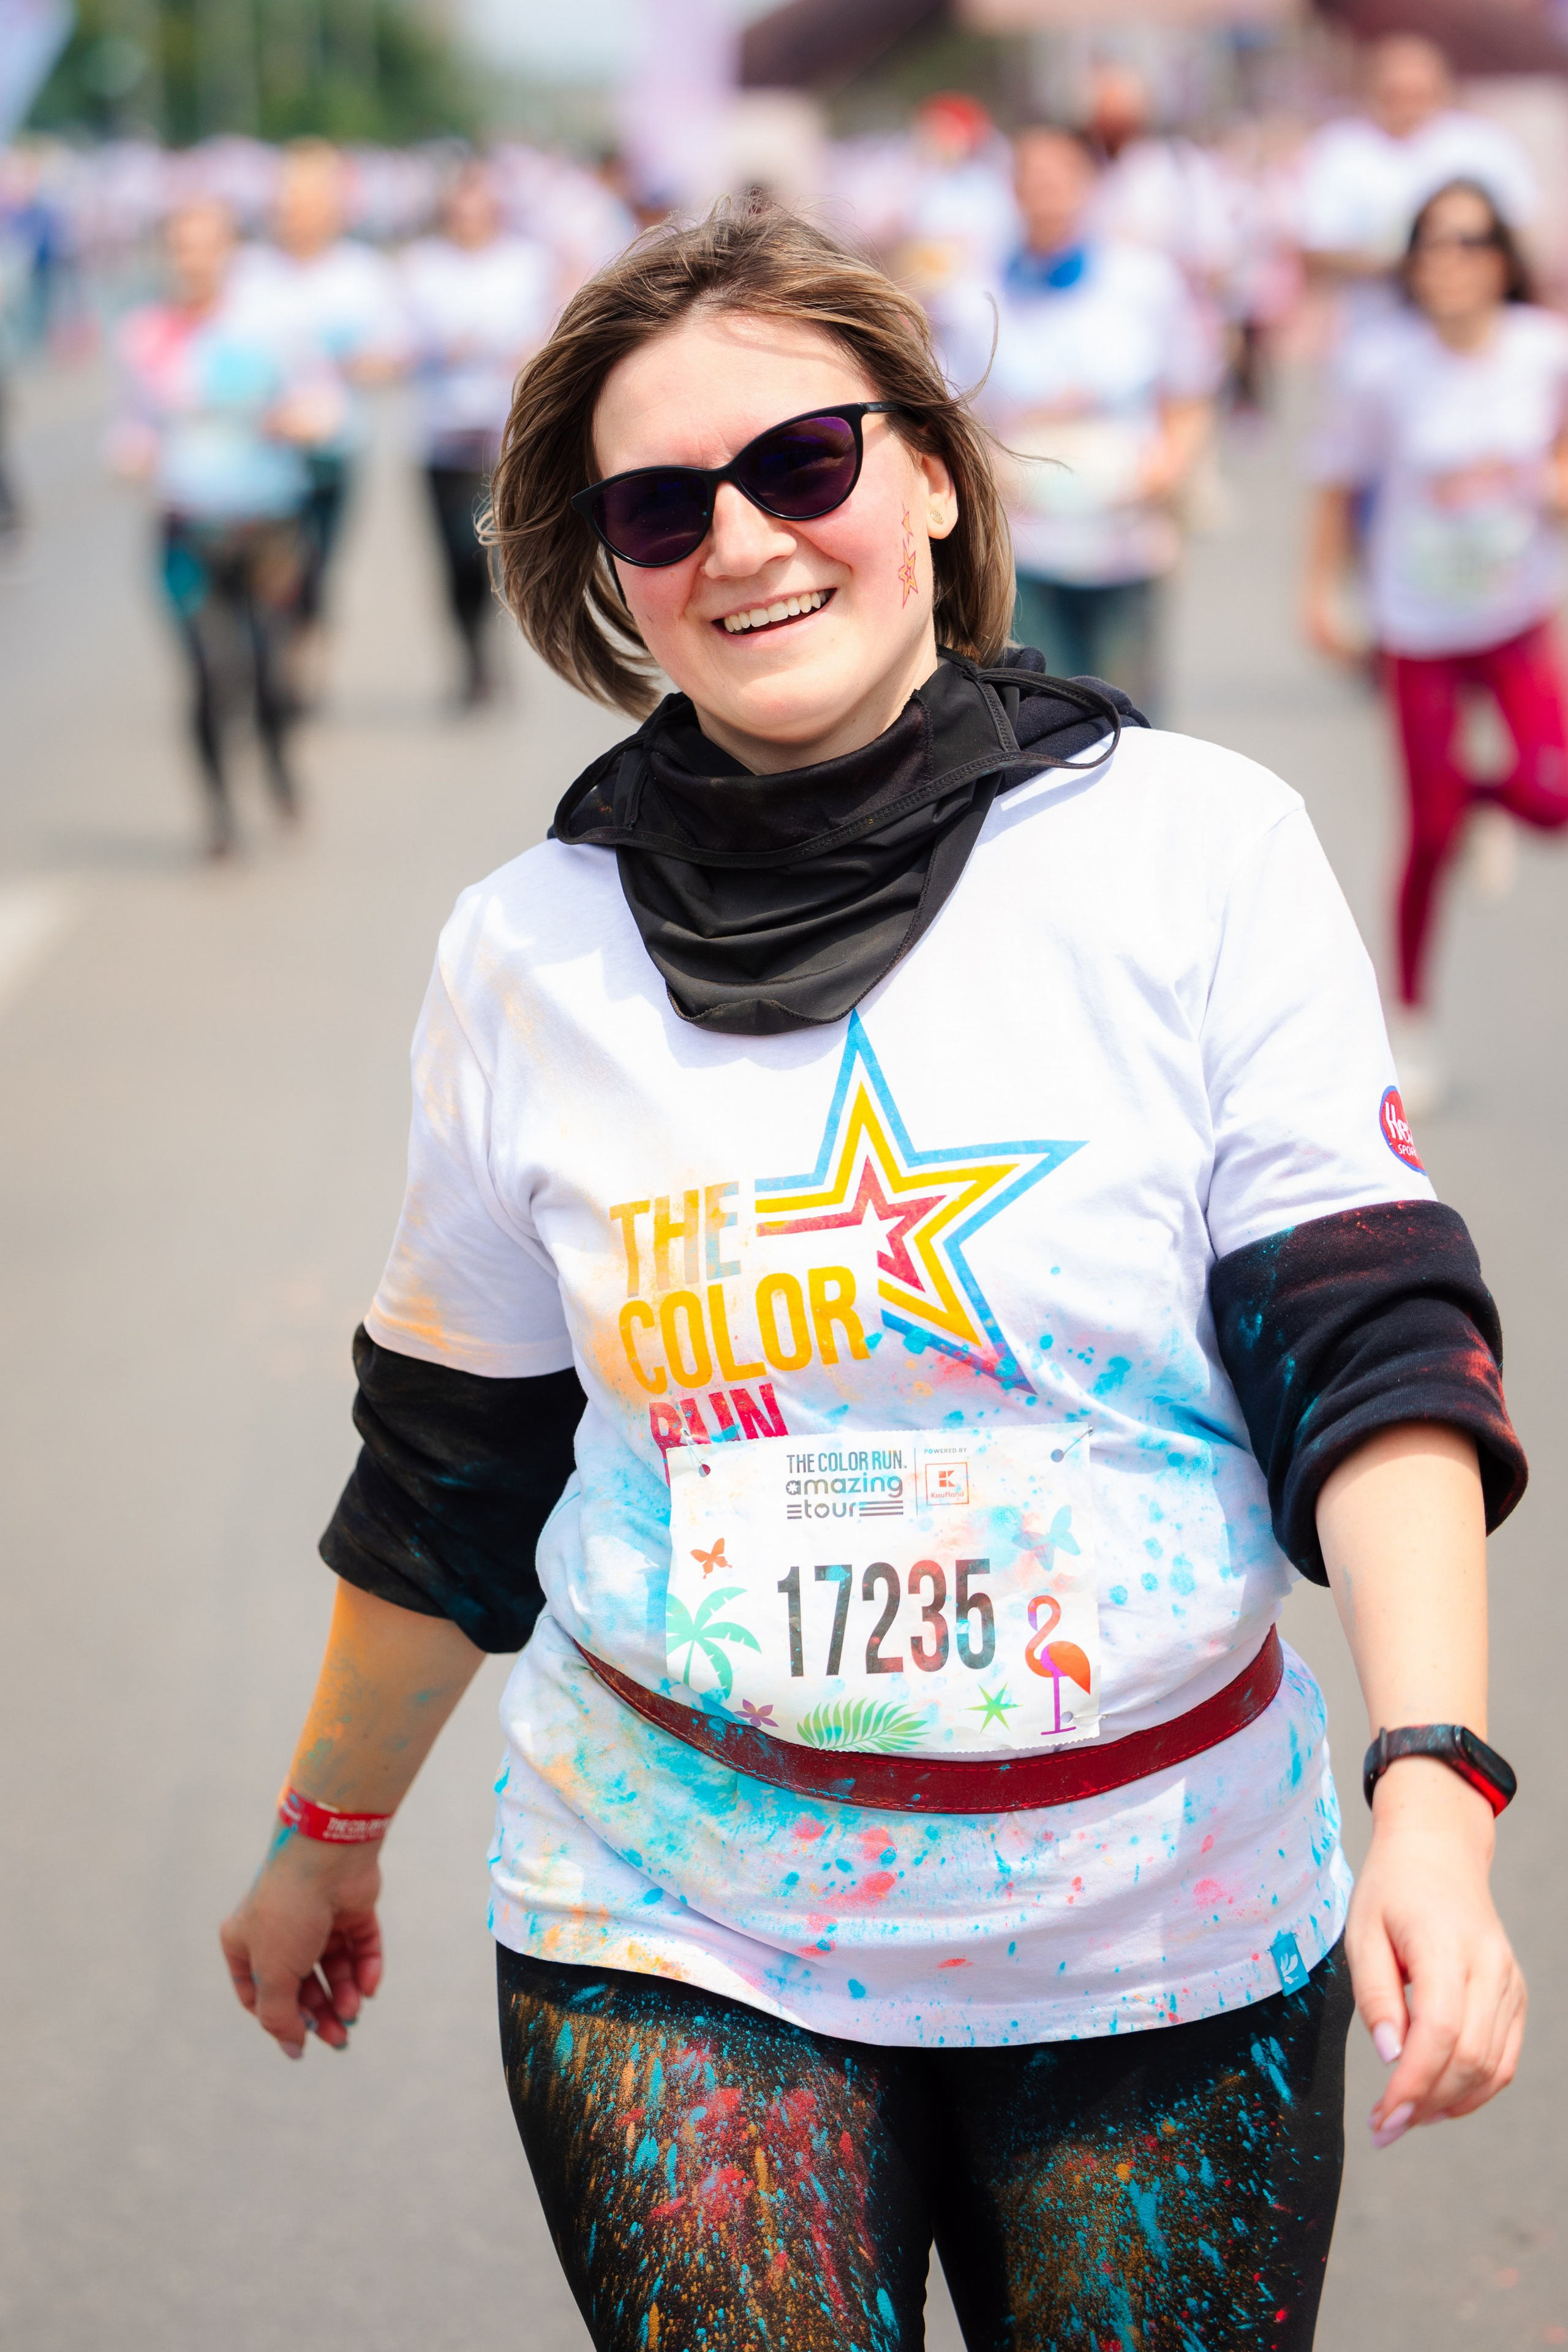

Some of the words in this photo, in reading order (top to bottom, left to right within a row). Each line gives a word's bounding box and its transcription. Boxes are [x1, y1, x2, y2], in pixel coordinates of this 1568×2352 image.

[1398, 1144, 1419, 1159] SPOR
[609, 1181, 741, 1298] THE
[619, 1265, 871, 1395] COLOR
[786, 1453, 815, 1473] THE
[818, 1451, 869, 1472] COLOR
[786, 1472, 903, 1498] amazing
[804, 1499, 857, 1518] tour
[777, 1558, 995, 1678] 17235
